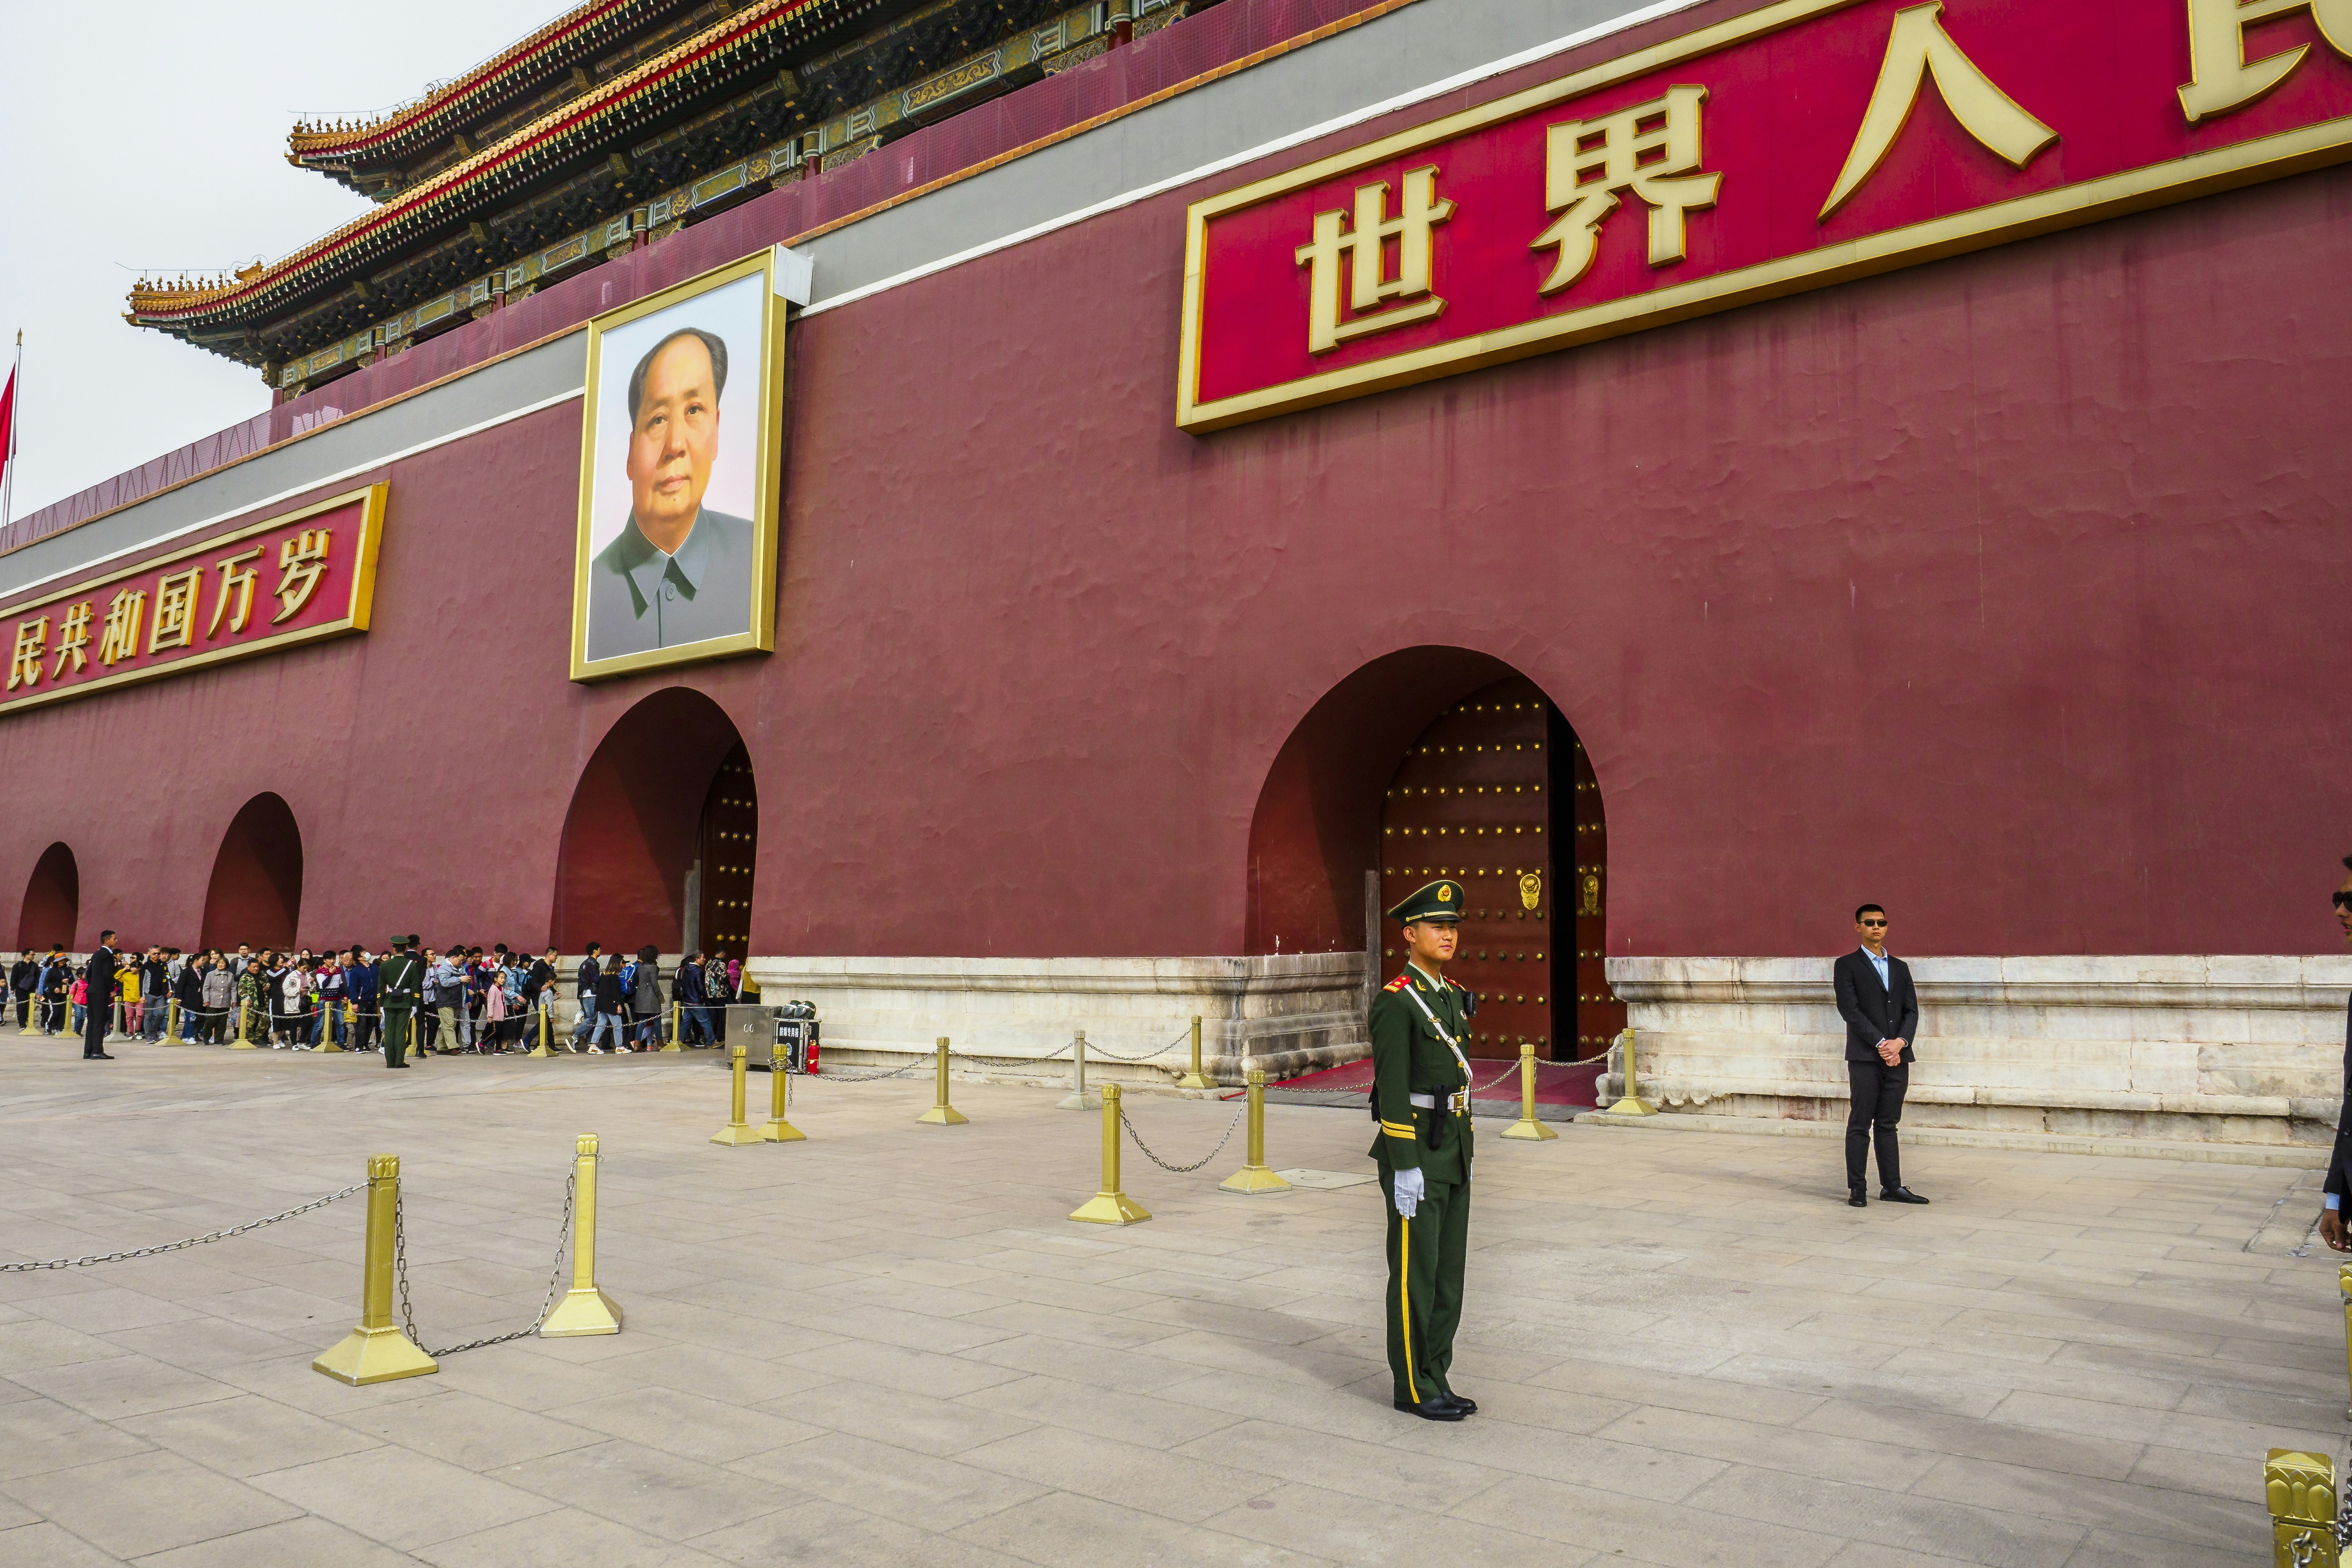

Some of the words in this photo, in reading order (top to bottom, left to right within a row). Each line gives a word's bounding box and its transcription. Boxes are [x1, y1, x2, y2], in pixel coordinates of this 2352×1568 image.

[7, 528, 332, 692] 民共和国万岁
